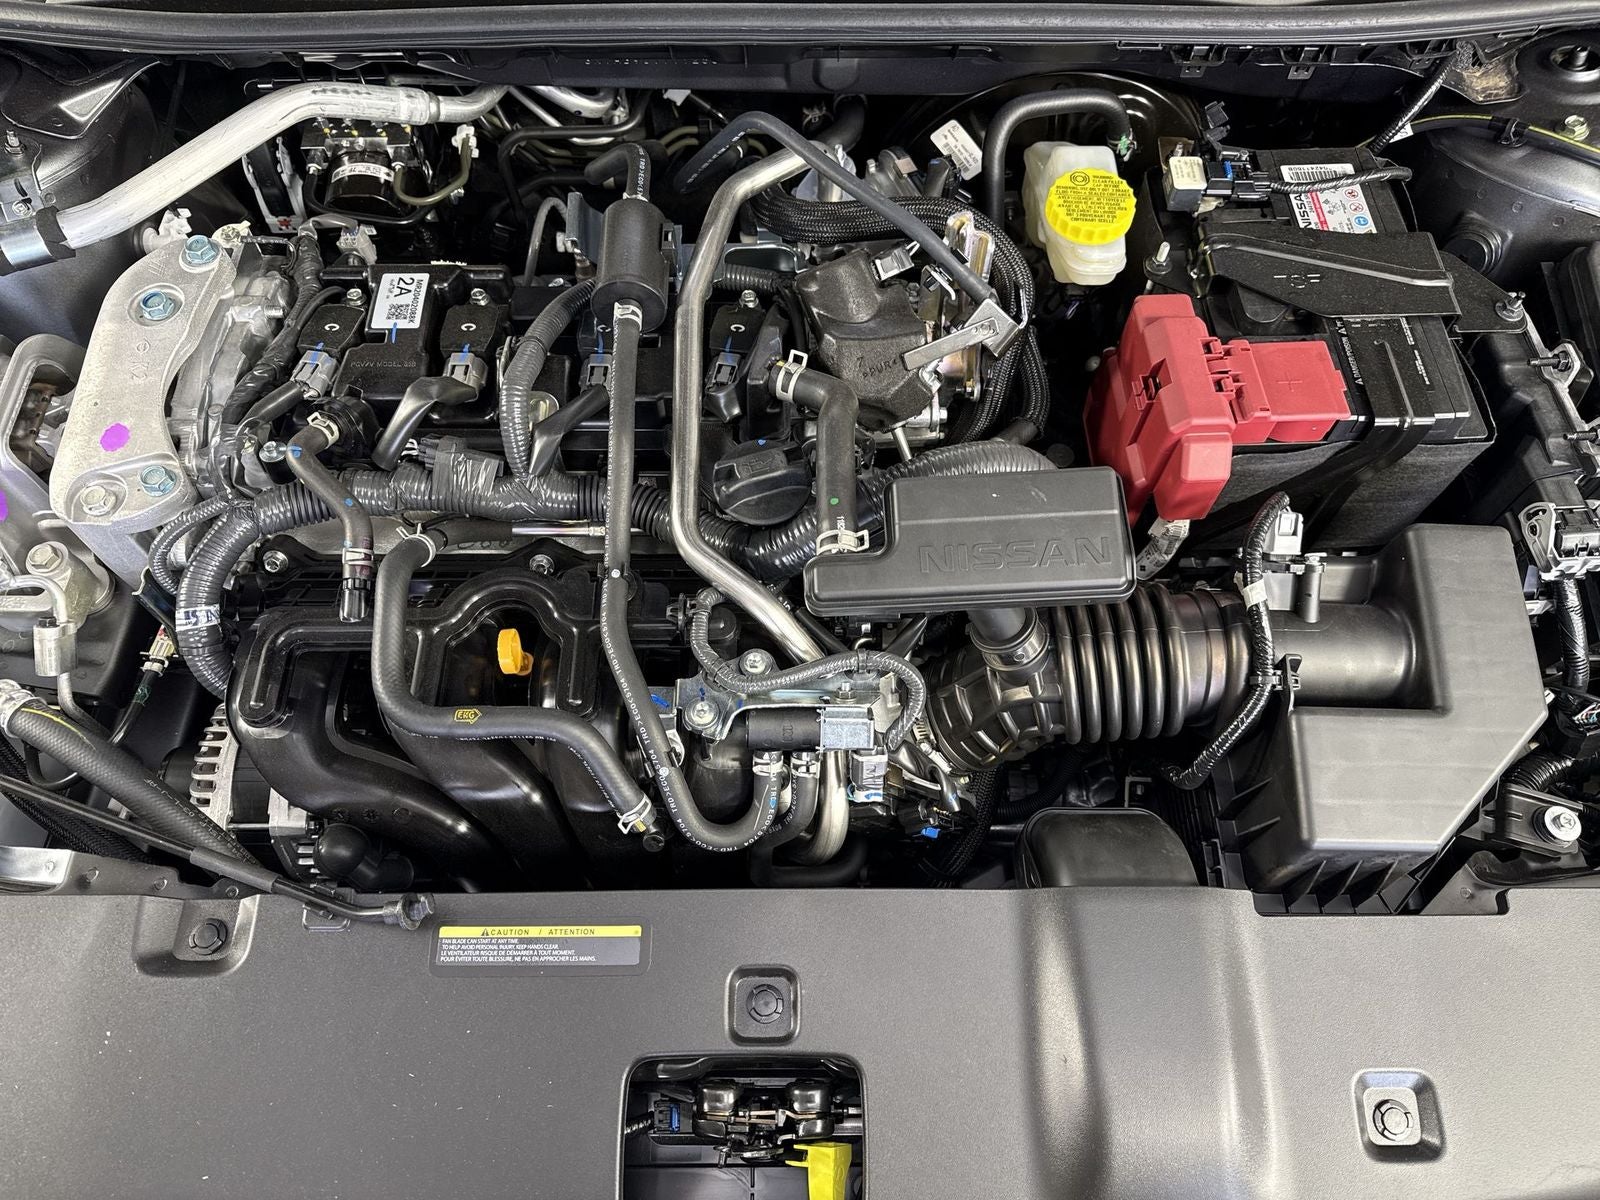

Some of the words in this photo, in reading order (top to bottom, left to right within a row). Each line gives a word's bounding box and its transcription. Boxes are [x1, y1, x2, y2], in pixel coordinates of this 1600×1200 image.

[1293, 193, 1313, 229] NISSA
[393, 276, 415, 298] 2A
[918, 536, 1113, 574] NISSAN
